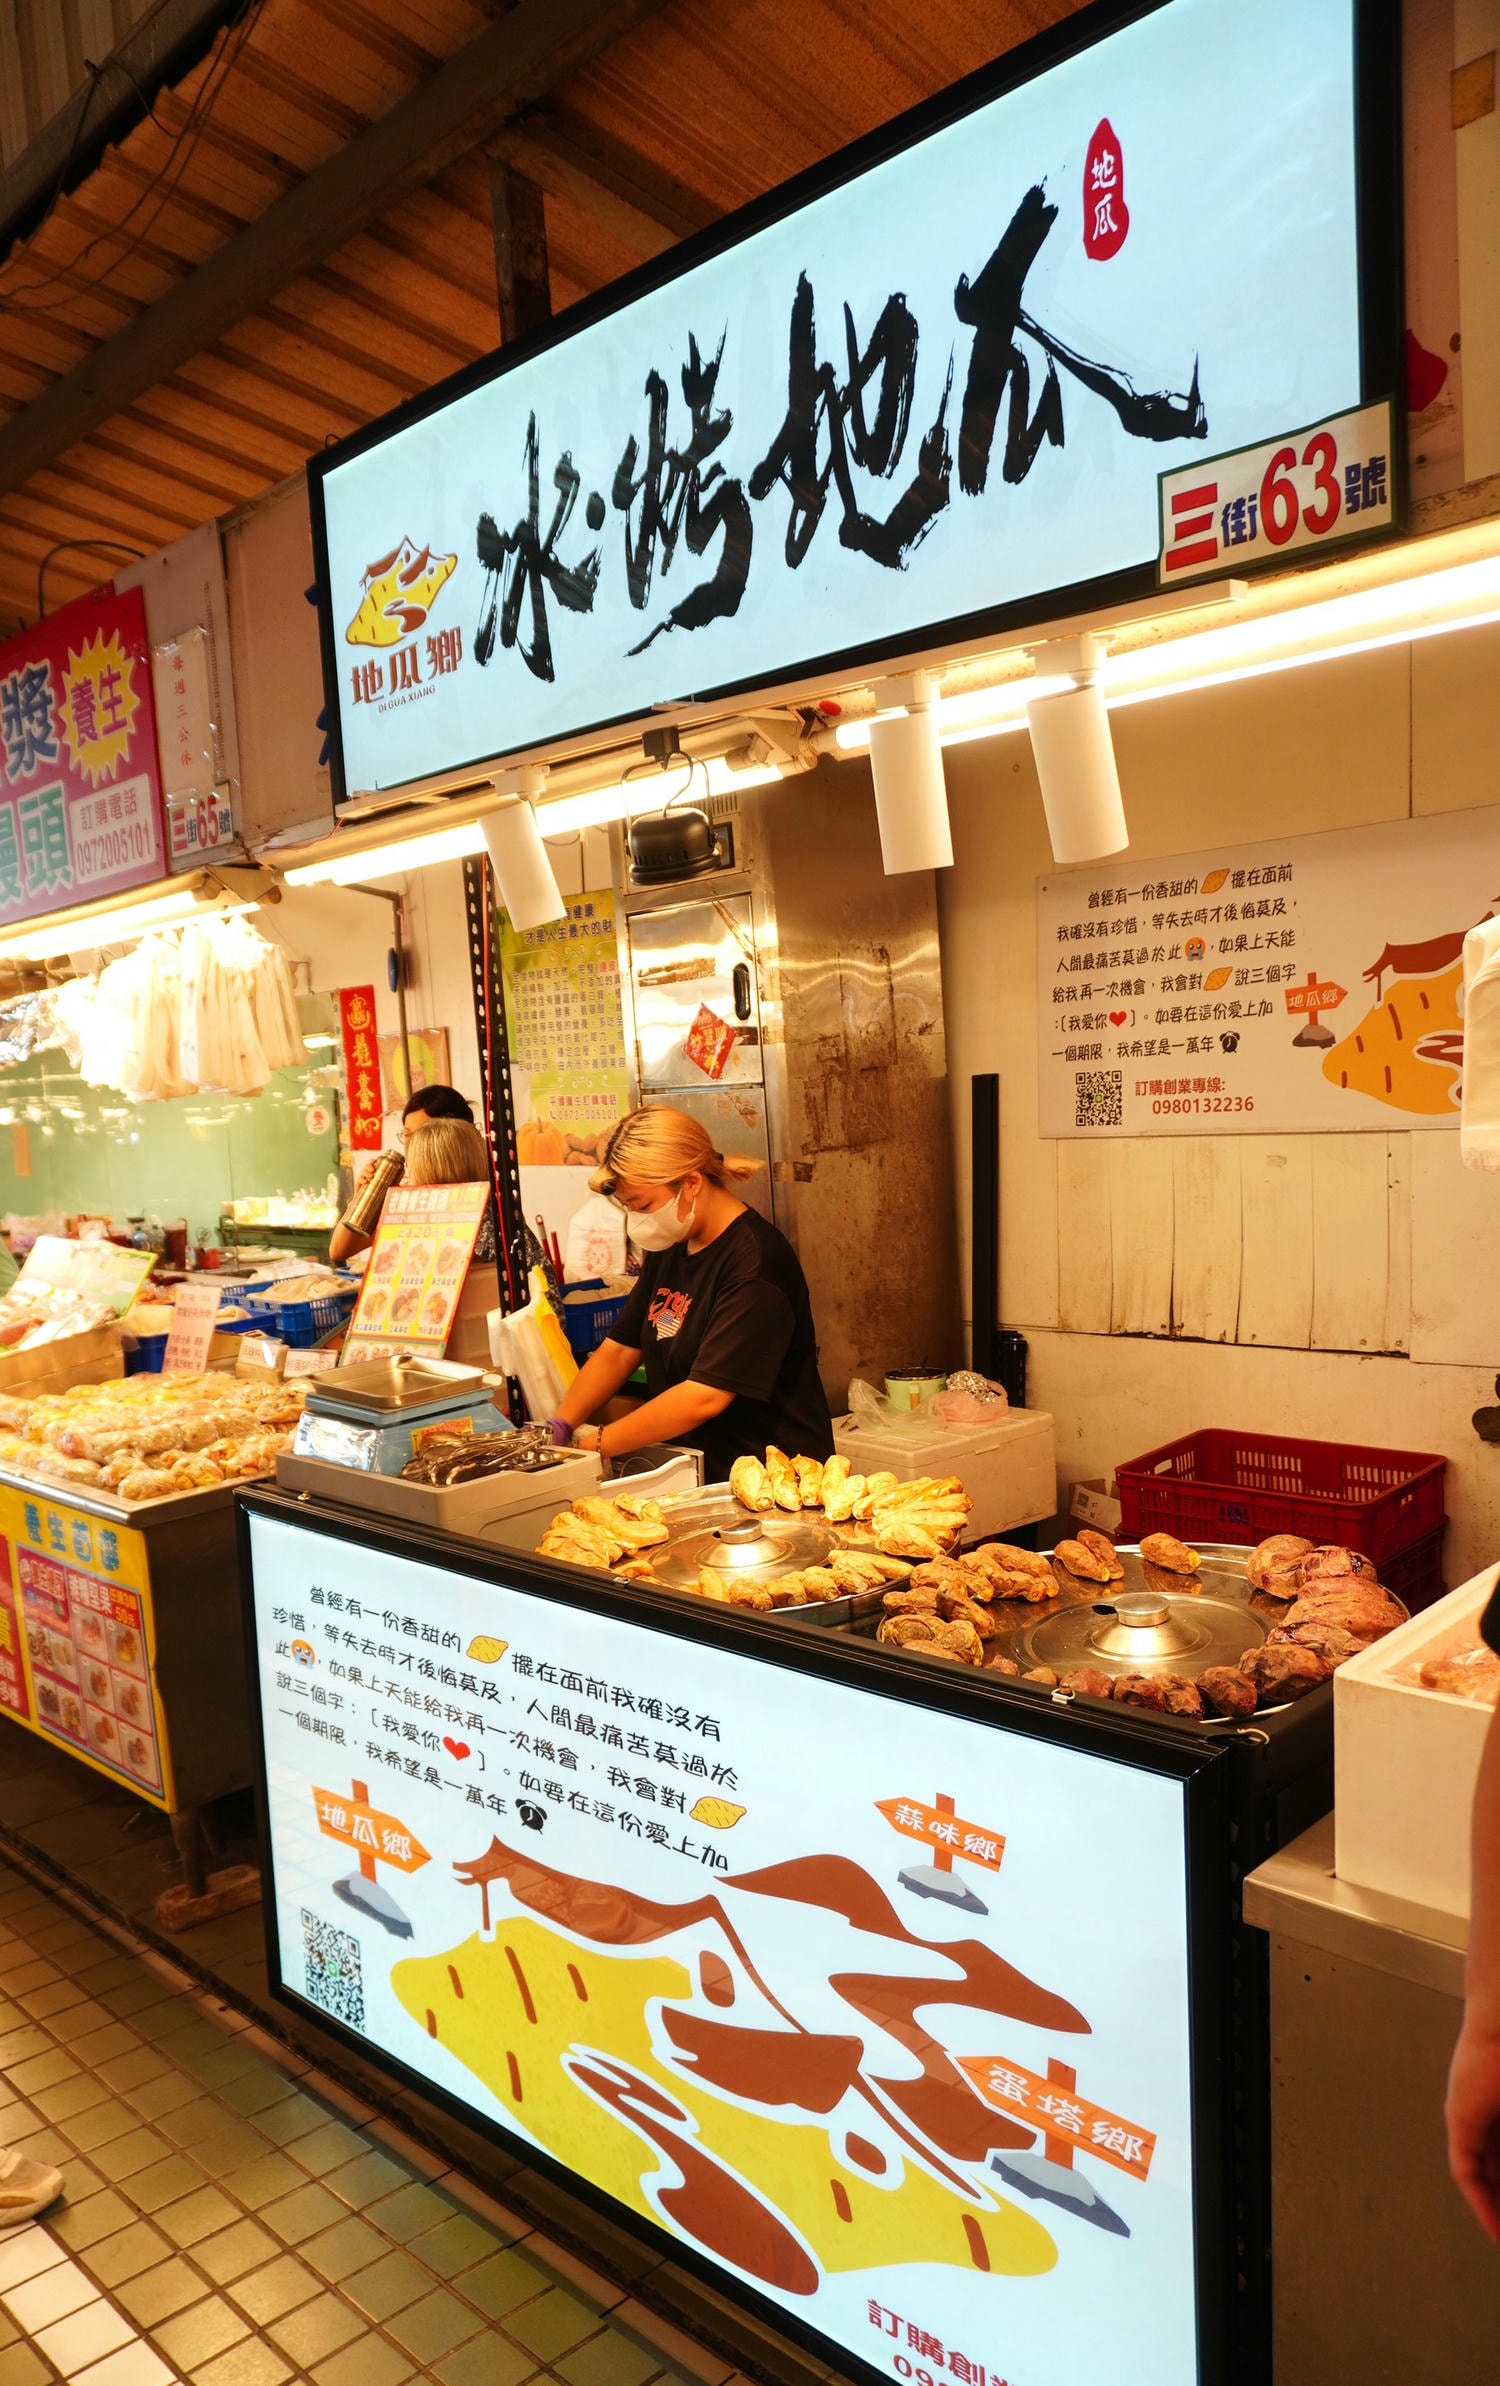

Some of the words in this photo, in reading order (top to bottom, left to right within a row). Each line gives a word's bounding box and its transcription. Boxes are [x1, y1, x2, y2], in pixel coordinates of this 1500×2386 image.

[1091, 149, 1118, 240] 地瓜
[1165, 432, 1387, 572] 三街63號
[351, 626, 462, 705] 地瓜鄉
[70, 664, 129, 748] 養生
[388, 696, 407, 710] GUA
[408, 684, 436, 702] XIANG
[80, 787, 137, 831] 訂購電話
[172, 794, 231, 851] 三街65號
[76, 819, 151, 876] 0972005101
[1088, 879, 1198, 909] 曾經有一份香甜的
[1231, 864, 1293, 889] 擺在面前
[1057, 945, 1181, 973] 人間最痛苦莫過於此
[1234, 963, 1297, 986] 說三個字
[1288, 988, 1338, 1009] 地瓜鄉
[1152, 1097, 1254, 1115] 0980132236
[275, 1640, 291, 1658] 此
[310, 1585, 461, 1653] 曾經有一份香甜的
[512, 1653, 721, 1742] 擺在面前我確沒有
[320, 1802, 413, 1863] 地瓜鄉
[895, 1803, 998, 1861] 蒜味鄉
[988, 2063, 1144, 2162] 蛋塔鄉
[867, 2298, 1019, 2386] 訂購創
[893, 2354, 952, 2386] 09
